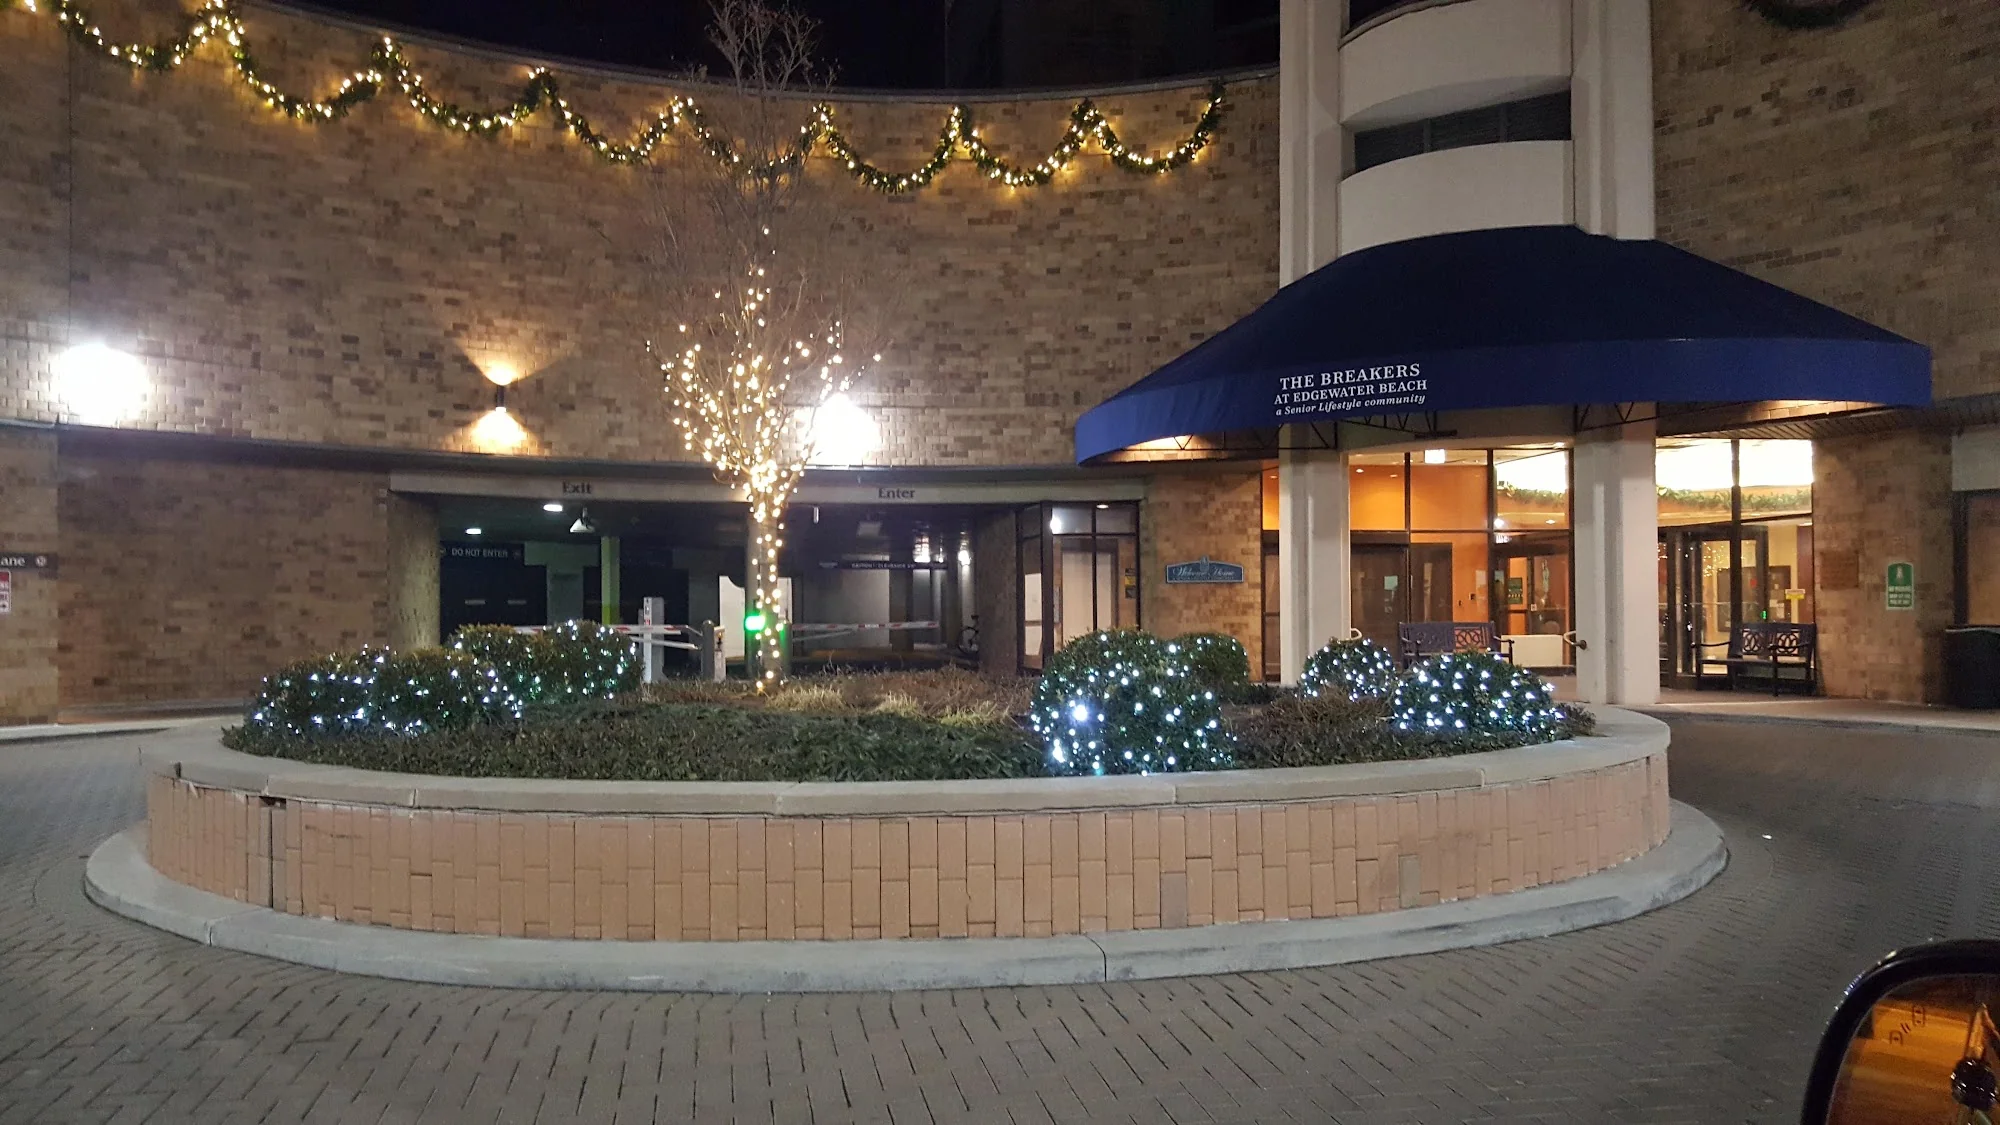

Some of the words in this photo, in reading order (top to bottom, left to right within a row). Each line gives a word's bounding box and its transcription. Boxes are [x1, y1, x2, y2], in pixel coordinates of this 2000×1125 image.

[1280, 374, 1315, 390] THE
[1321, 363, 1420, 386] BREAKERS
[1274, 393, 1290, 405] AT
[1293, 385, 1375, 402] EDGEWATER
[1379, 379, 1428, 394] BEACH
[1275, 408, 1282, 416] a
[1284, 404, 1316, 415] Senior
[1318, 400, 1362, 413] Lifestyle
[1364, 393, 1426, 407] community
[562, 481, 592, 494] Exit
[878, 487, 916, 499] Enter
[451, 547, 464, 557] DO
[465, 548, 481, 558] NOT
[482, 549, 508, 559] ENTER
